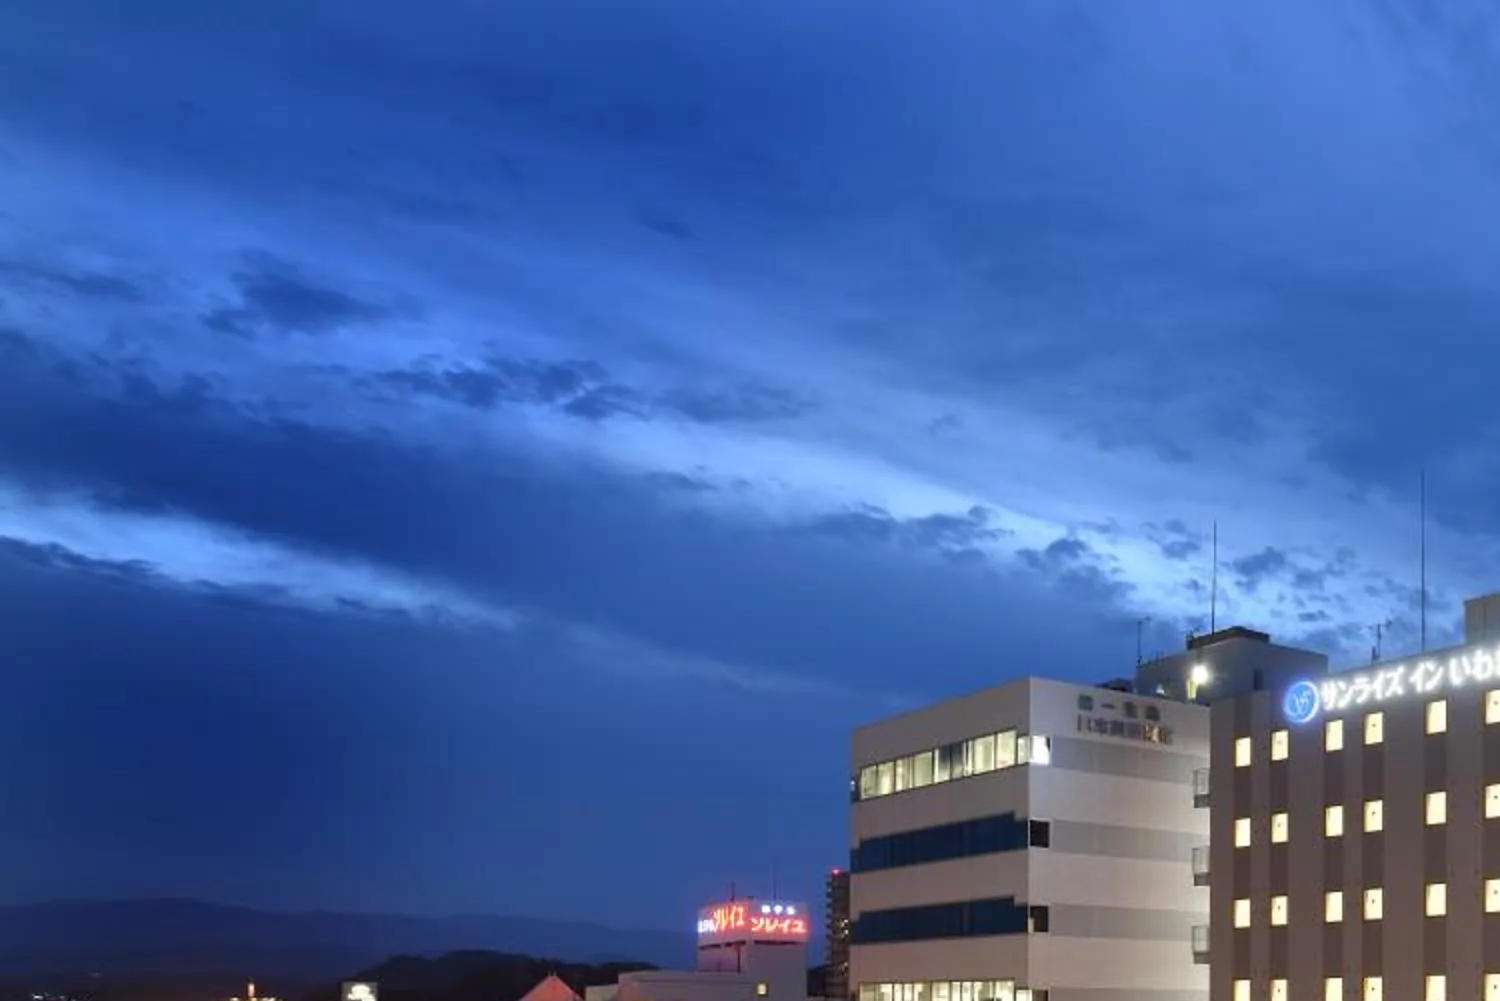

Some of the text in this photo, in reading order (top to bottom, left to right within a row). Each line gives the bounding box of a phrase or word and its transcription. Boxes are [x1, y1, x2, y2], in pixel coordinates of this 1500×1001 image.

[1321, 664, 1405, 710] サンライズ
[1410, 659, 1444, 692] イン
